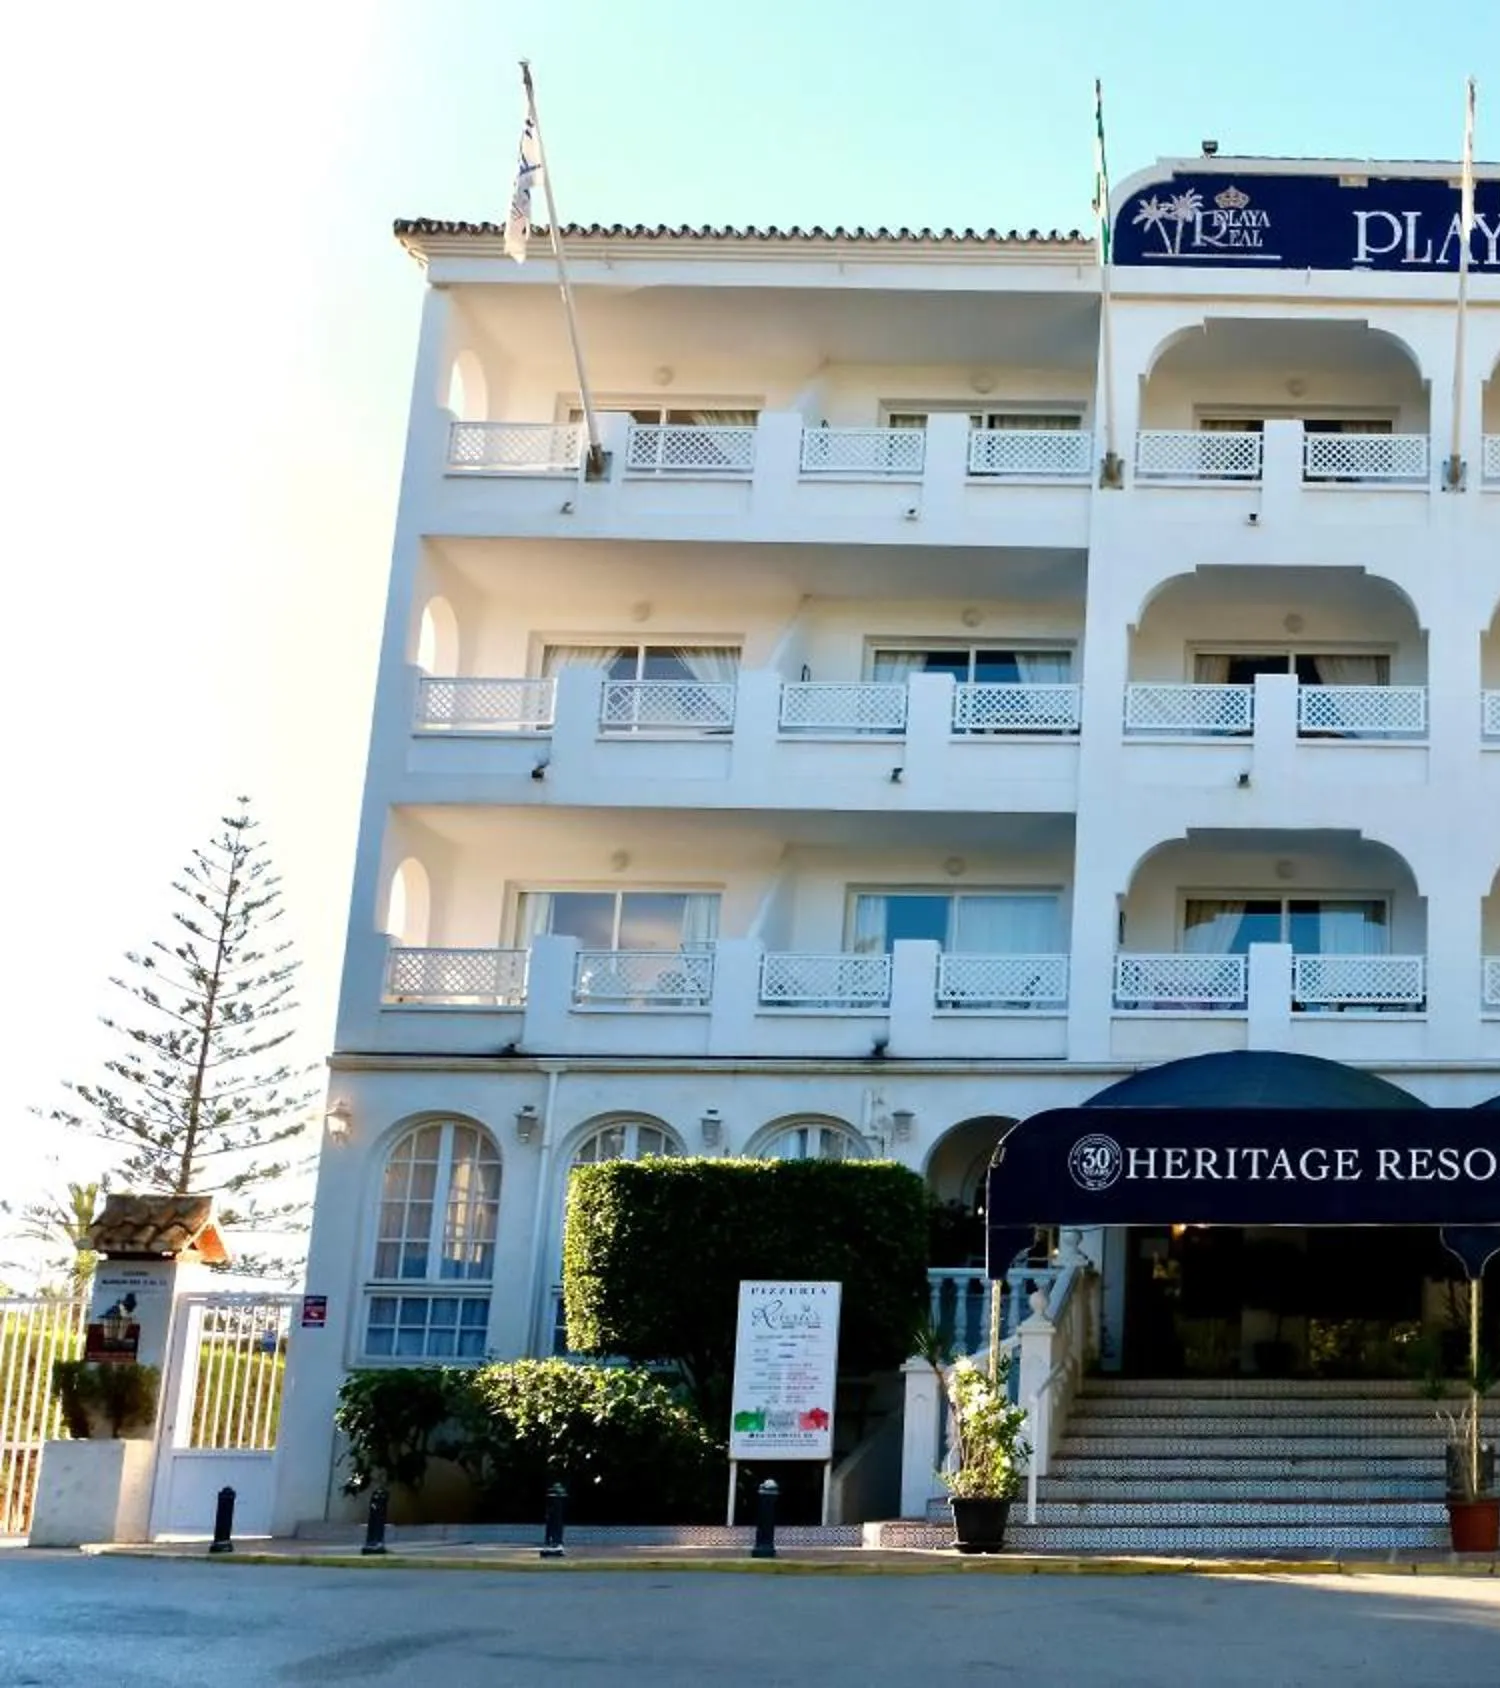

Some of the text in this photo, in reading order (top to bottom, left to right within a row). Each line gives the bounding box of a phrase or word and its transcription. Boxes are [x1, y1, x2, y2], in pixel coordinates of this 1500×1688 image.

[1212, 209, 1271, 228] PLAYA
[1082, 1147, 1110, 1169] 30
[1125, 1147, 1363, 1182] HERITAGE
